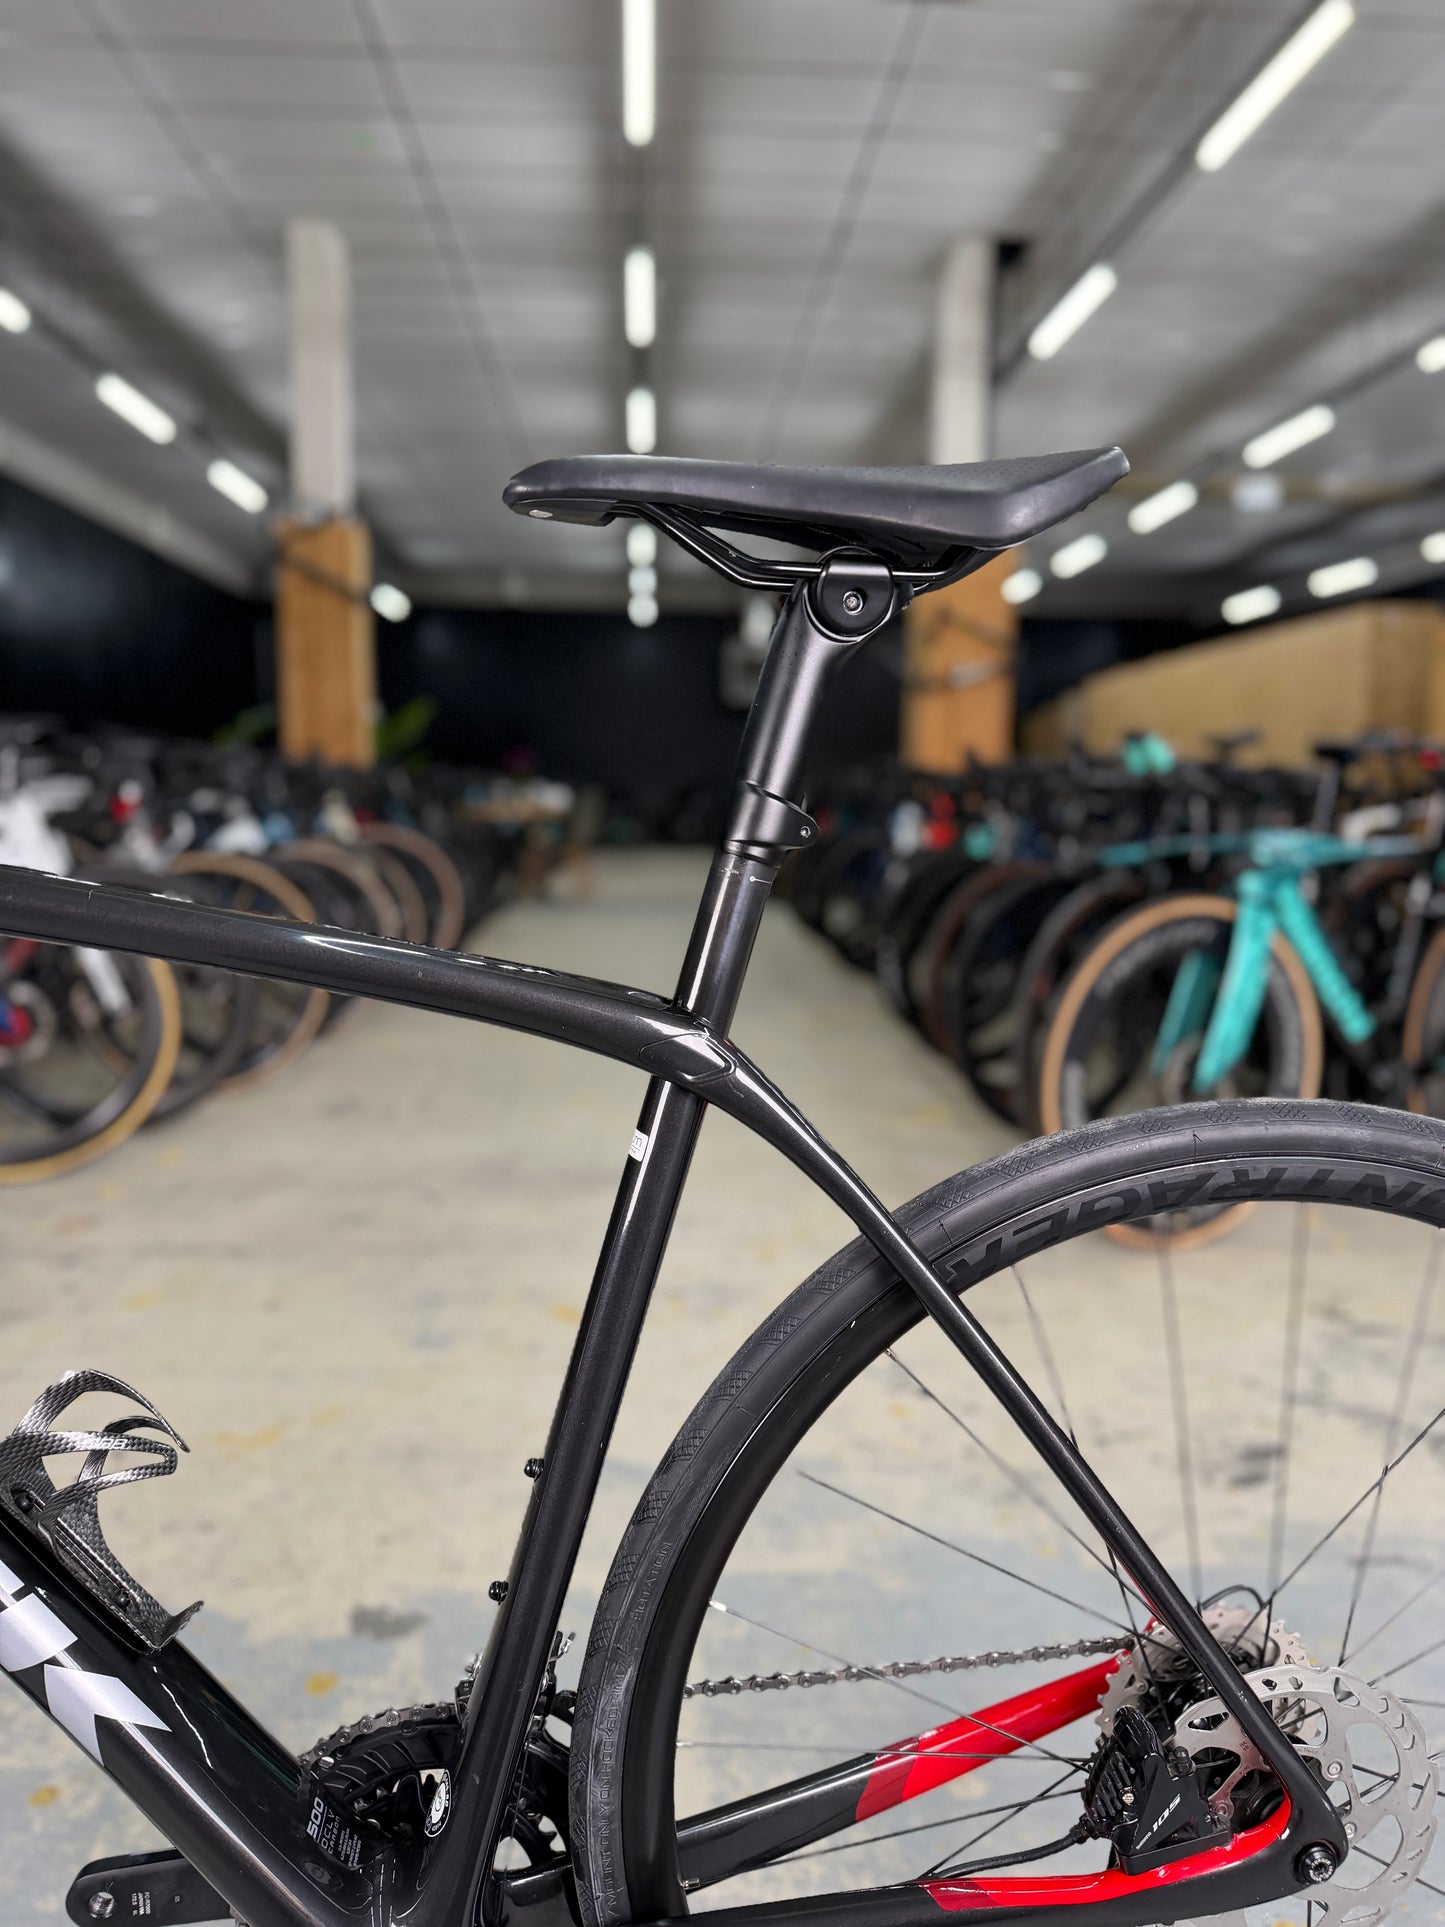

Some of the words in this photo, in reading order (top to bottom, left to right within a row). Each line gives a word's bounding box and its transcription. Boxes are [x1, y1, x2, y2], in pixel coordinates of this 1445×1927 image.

[306, 1796, 325, 1840] 500
[320, 1809, 335, 1850] OCLV
[1151, 1793, 1182, 1833] 105
